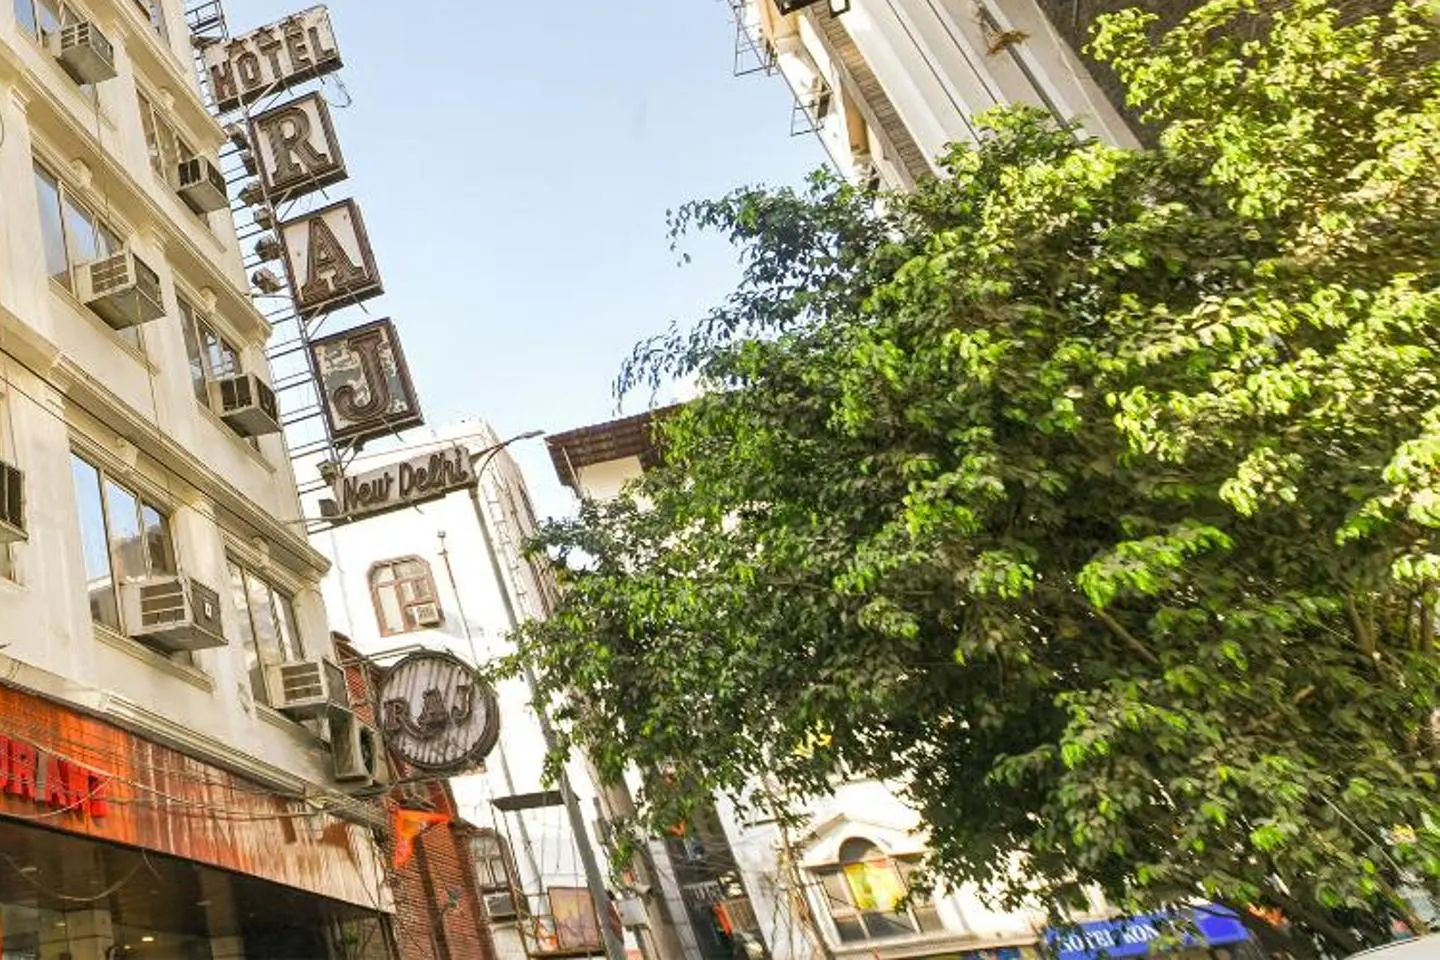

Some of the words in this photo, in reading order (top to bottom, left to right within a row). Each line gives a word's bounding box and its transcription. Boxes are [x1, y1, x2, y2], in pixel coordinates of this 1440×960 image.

[211, 26, 336, 102] HOTEL
[260, 103, 392, 421] RAJ
[343, 472, 394, 513] New
[399, 446, 468, 498] Delhi
[384, 685, 474, 740] RAJ
